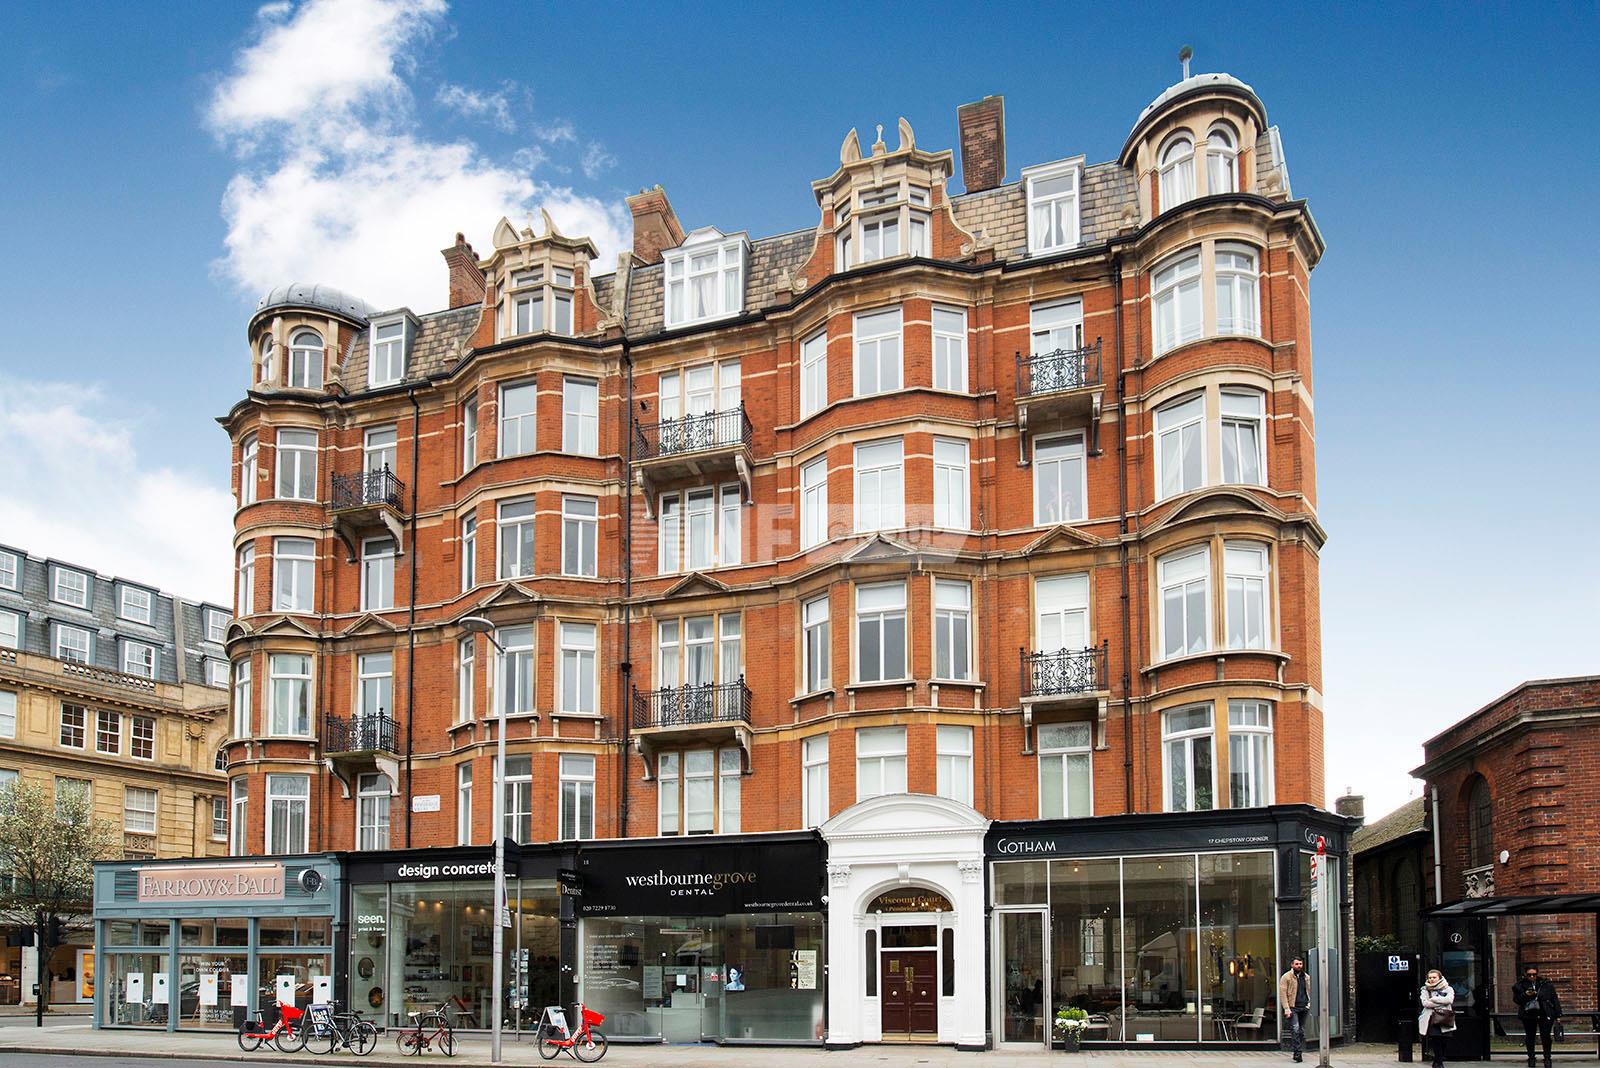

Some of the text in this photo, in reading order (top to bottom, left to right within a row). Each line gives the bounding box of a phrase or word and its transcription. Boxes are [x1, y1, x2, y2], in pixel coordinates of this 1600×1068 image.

[997, 838, 1057, 854] GOTHAM
[398, 863, 439, 878] design
[561, 883, 582, 896] Dentist
[670, 888, 715, 896] DENTAL
[879, 896, 916, 904] Viscount
